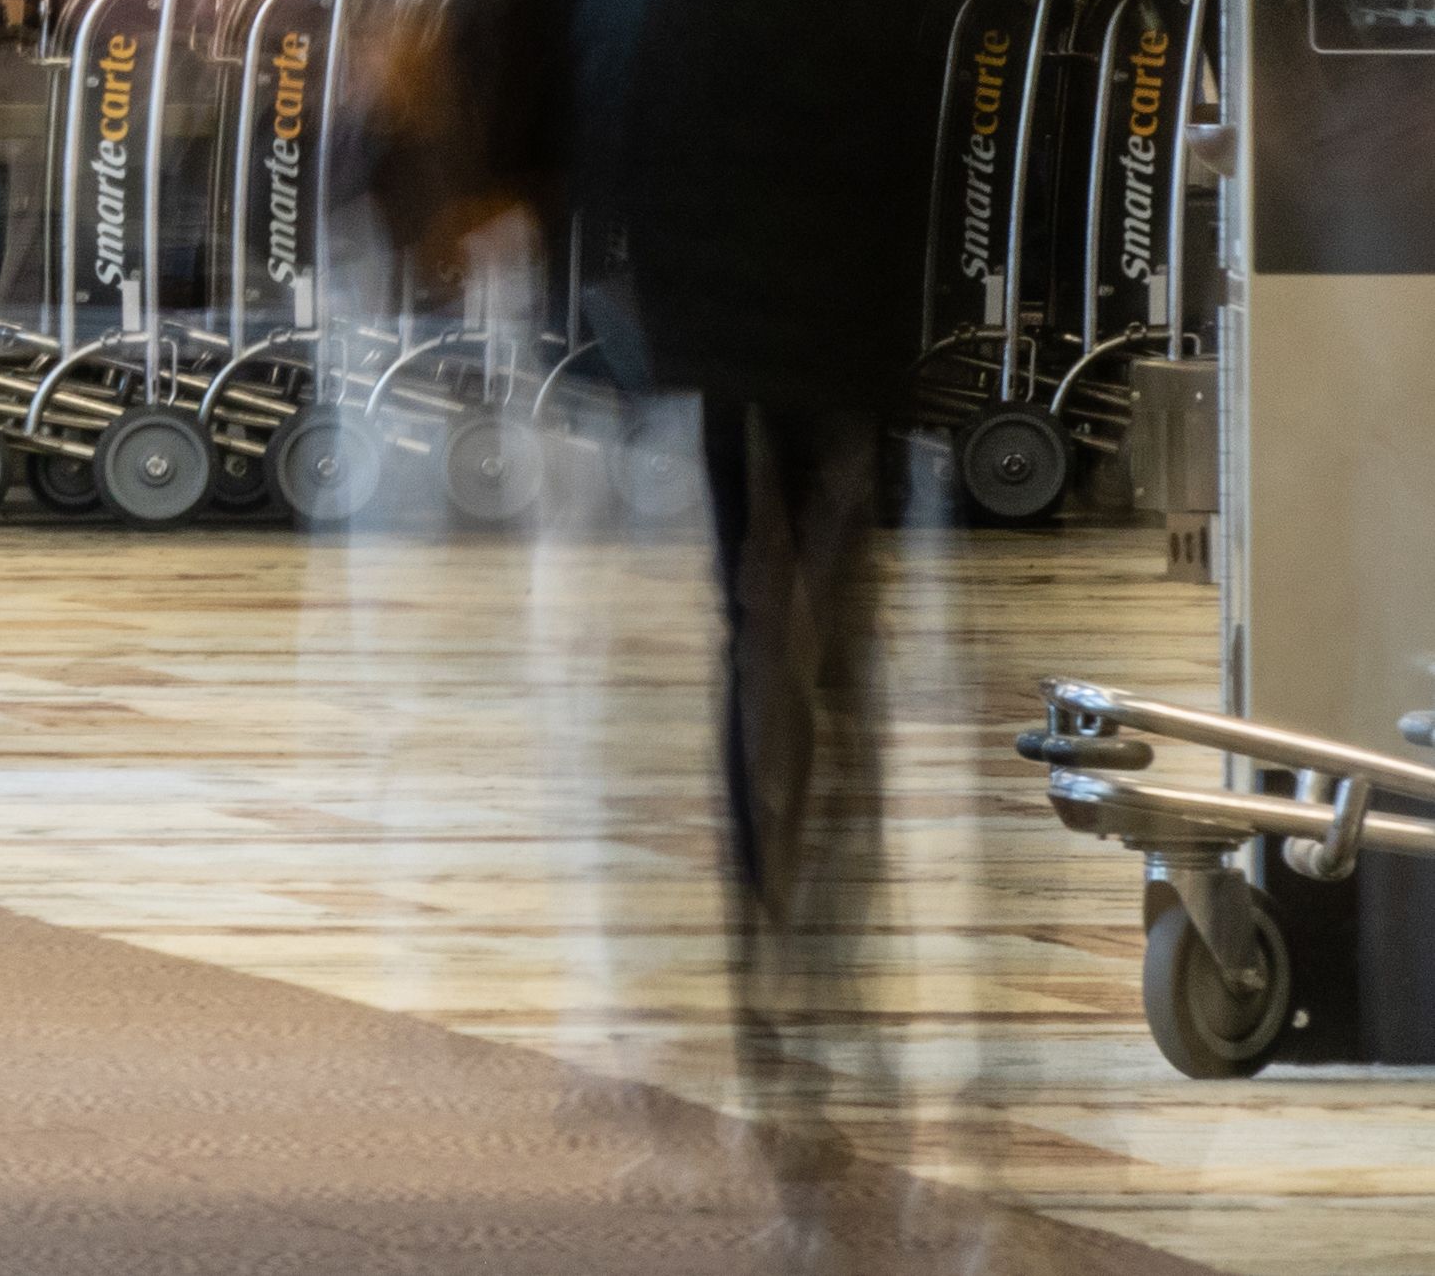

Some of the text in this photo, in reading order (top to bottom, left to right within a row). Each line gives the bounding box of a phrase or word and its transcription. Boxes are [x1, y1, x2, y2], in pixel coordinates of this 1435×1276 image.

[91, 34, 138, 289] smartecarte
[265, 31, 310, 287] smartecarte
[962, 28, 1011, 285] smartecarte
[1120, 28, 1170, 285] smartecarte
